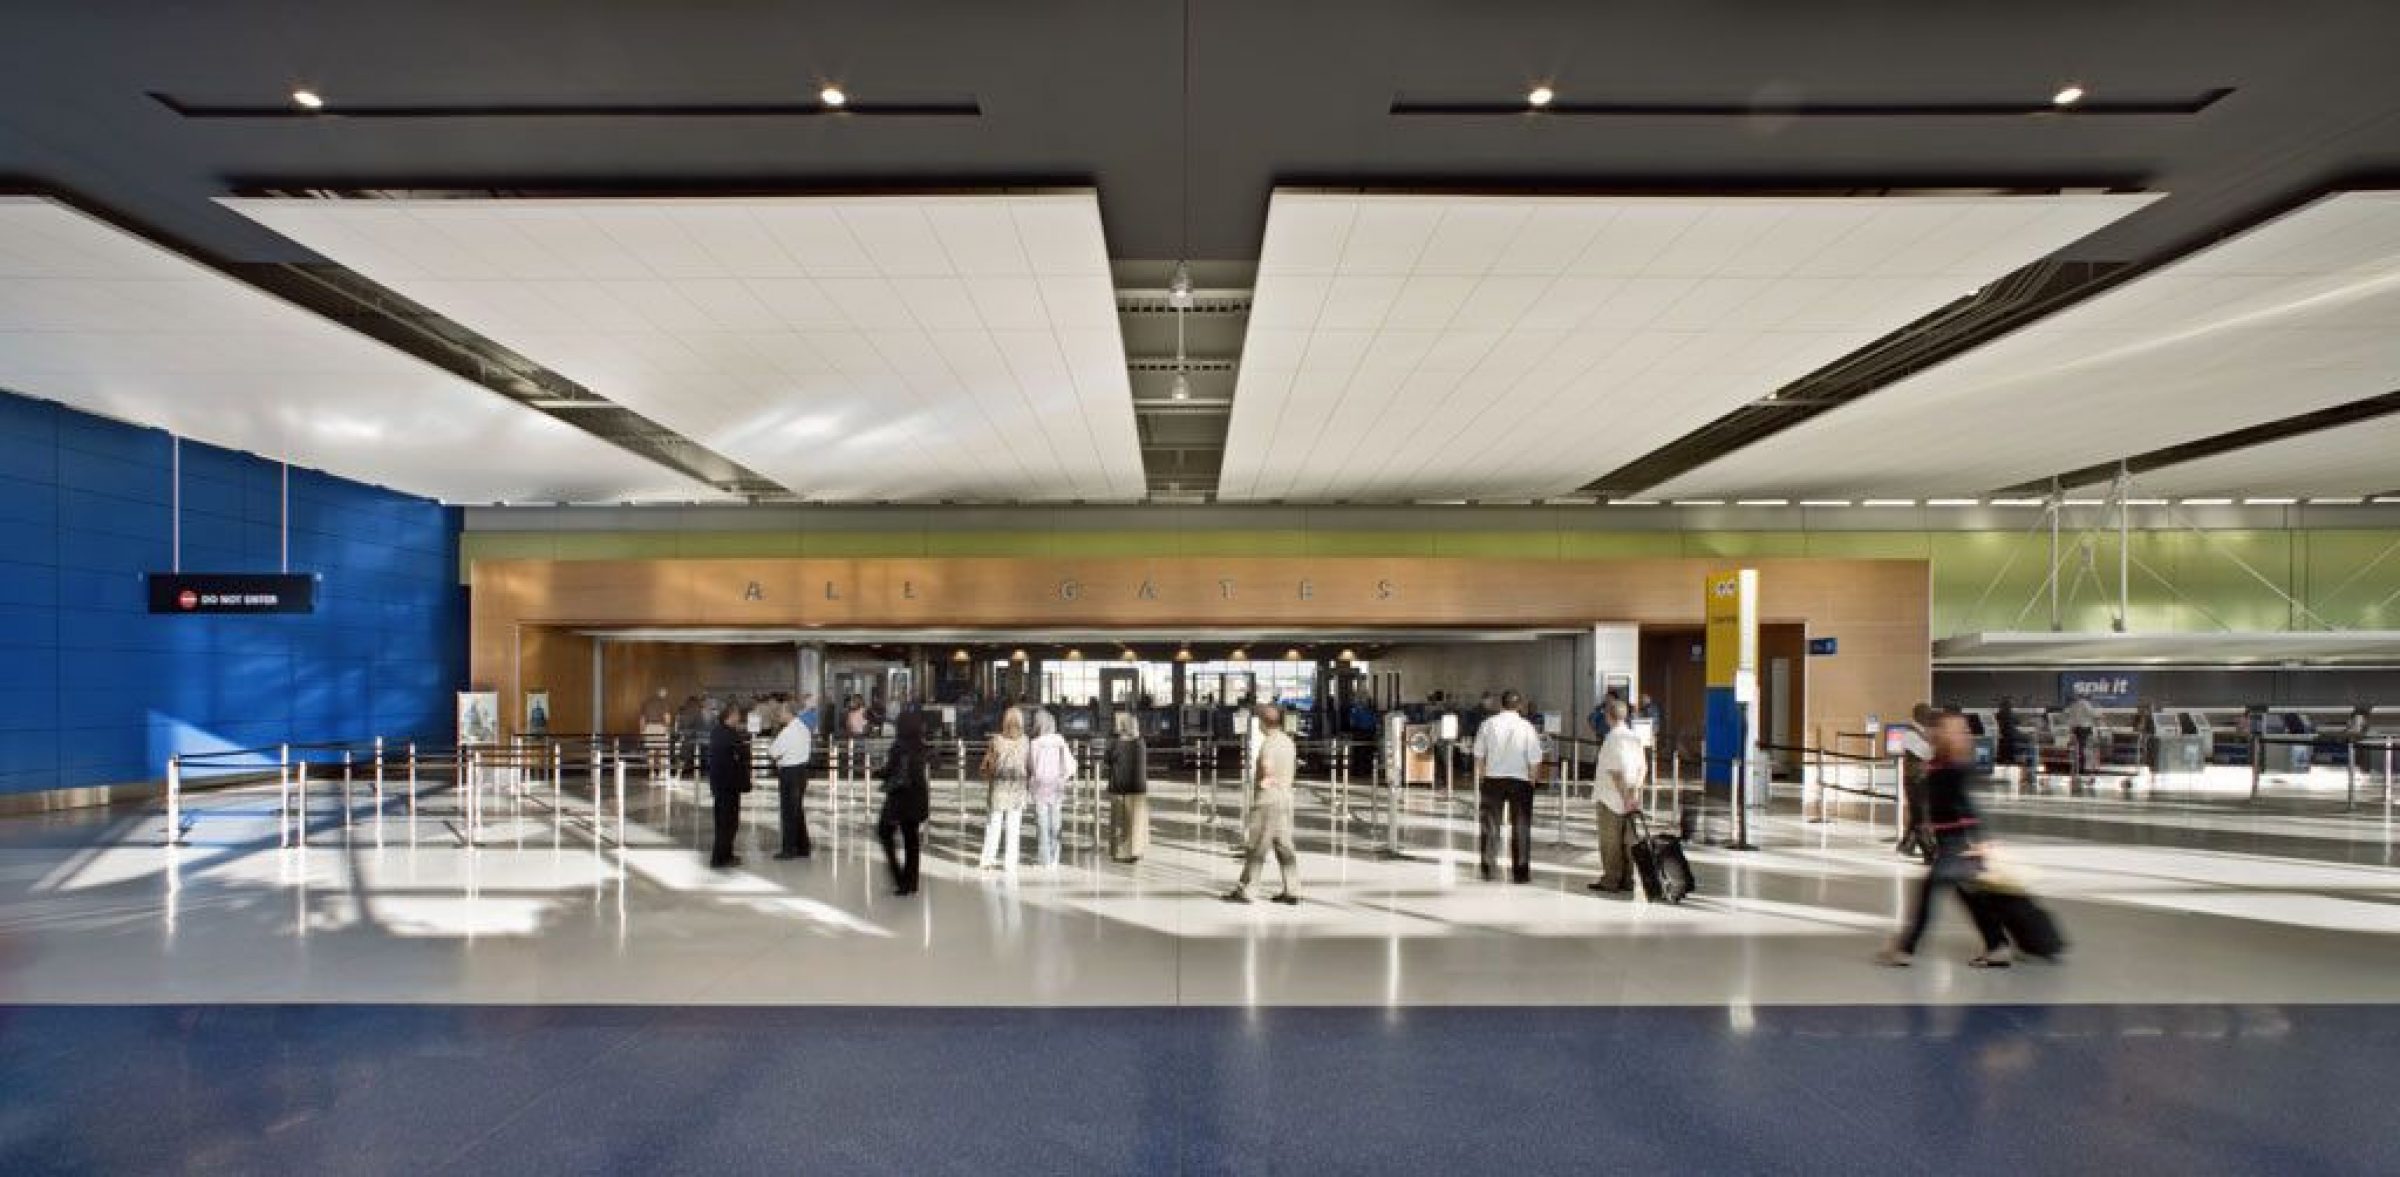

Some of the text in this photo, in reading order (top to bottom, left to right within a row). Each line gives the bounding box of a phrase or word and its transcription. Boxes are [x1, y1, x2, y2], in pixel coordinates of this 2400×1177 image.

[201, 594, 277, 605] DO NOT ENTER
